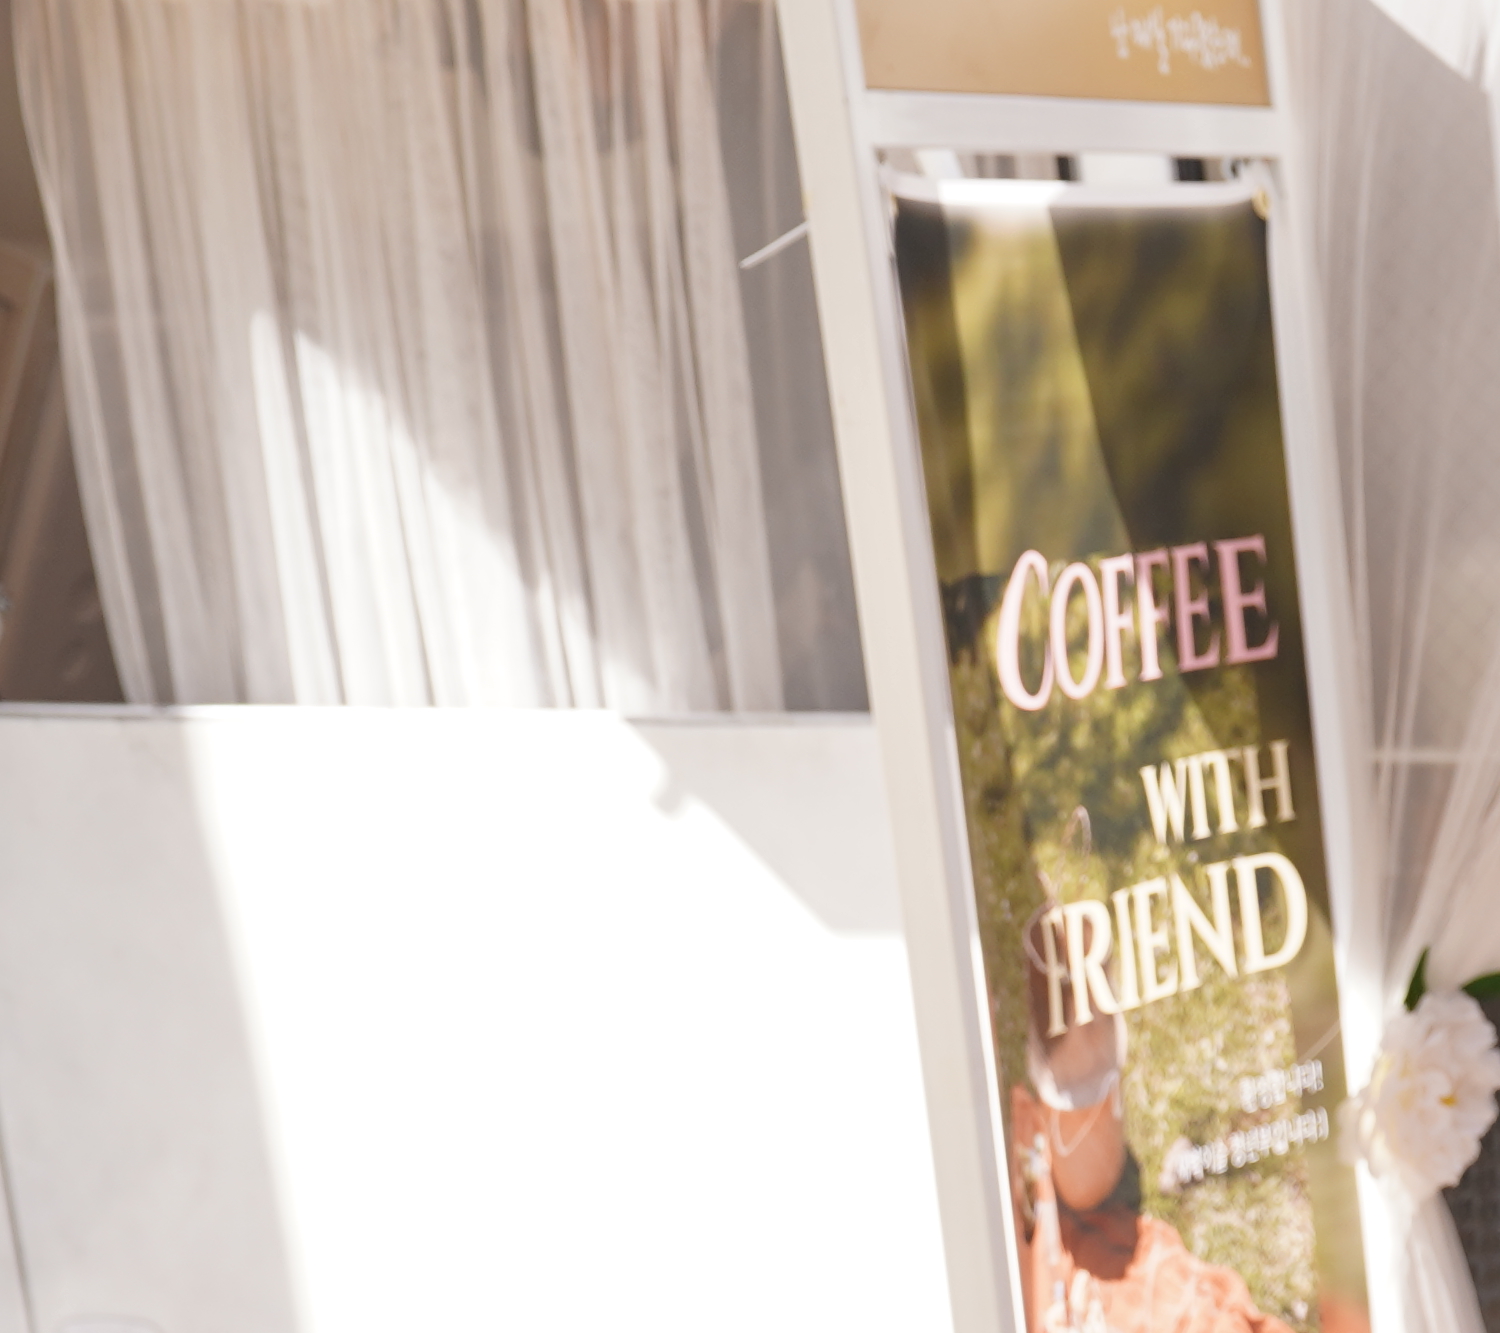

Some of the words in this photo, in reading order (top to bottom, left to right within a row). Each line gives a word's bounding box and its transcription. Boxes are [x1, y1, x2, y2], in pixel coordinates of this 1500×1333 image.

[997, 534, 1280, 711] COFFEE
[1140, 739, 1297, 843] WITH
[1042, 851, 1308, 1038] FRIEND
